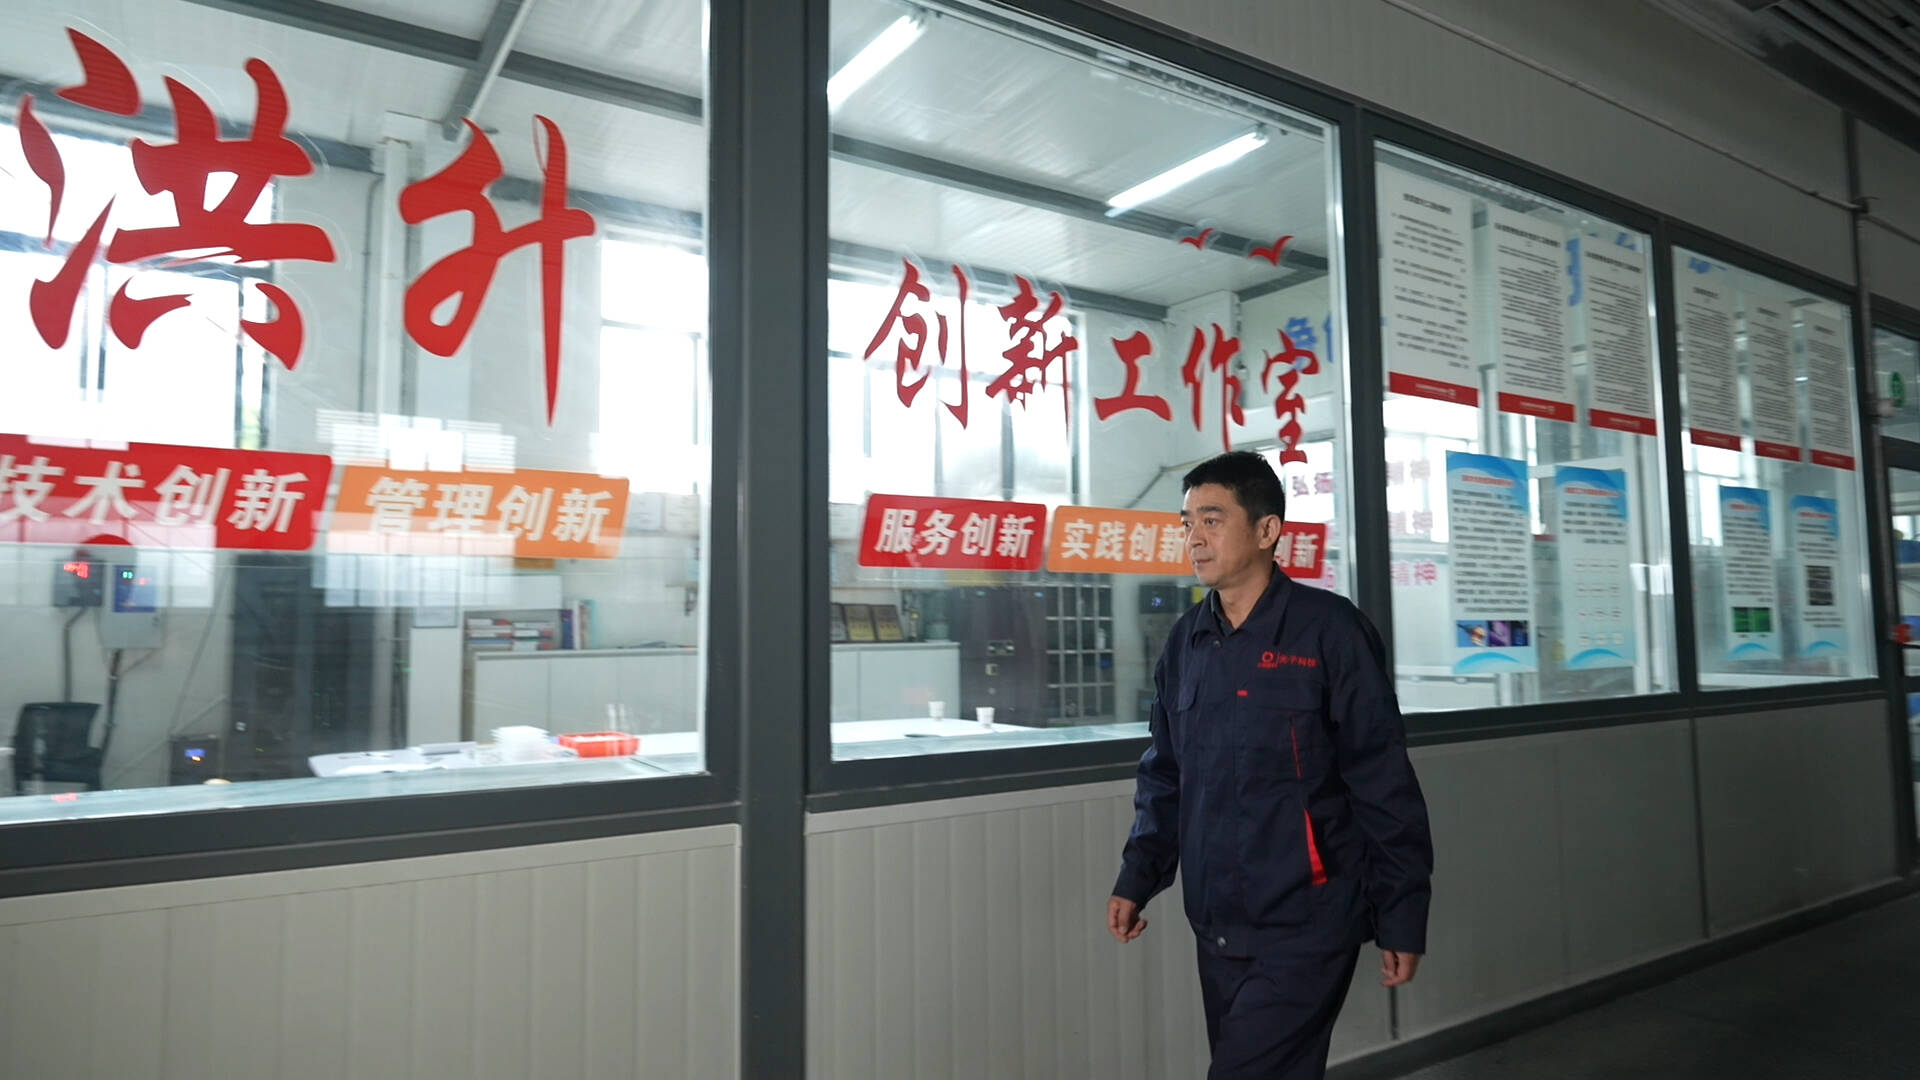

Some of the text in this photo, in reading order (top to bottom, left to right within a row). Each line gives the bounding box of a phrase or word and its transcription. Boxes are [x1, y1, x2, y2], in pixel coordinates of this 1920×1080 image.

[17, 27, 596, 428] 洪升
[864, 256, 1321, 466] 创新工作室
[0, 454, 309, 533] 技术创新
[364, 476, 613, 545] 管理创新
[874, 507, 1035, 559] 服务创新
[1060, 518, 1186, 565] 实践创新
